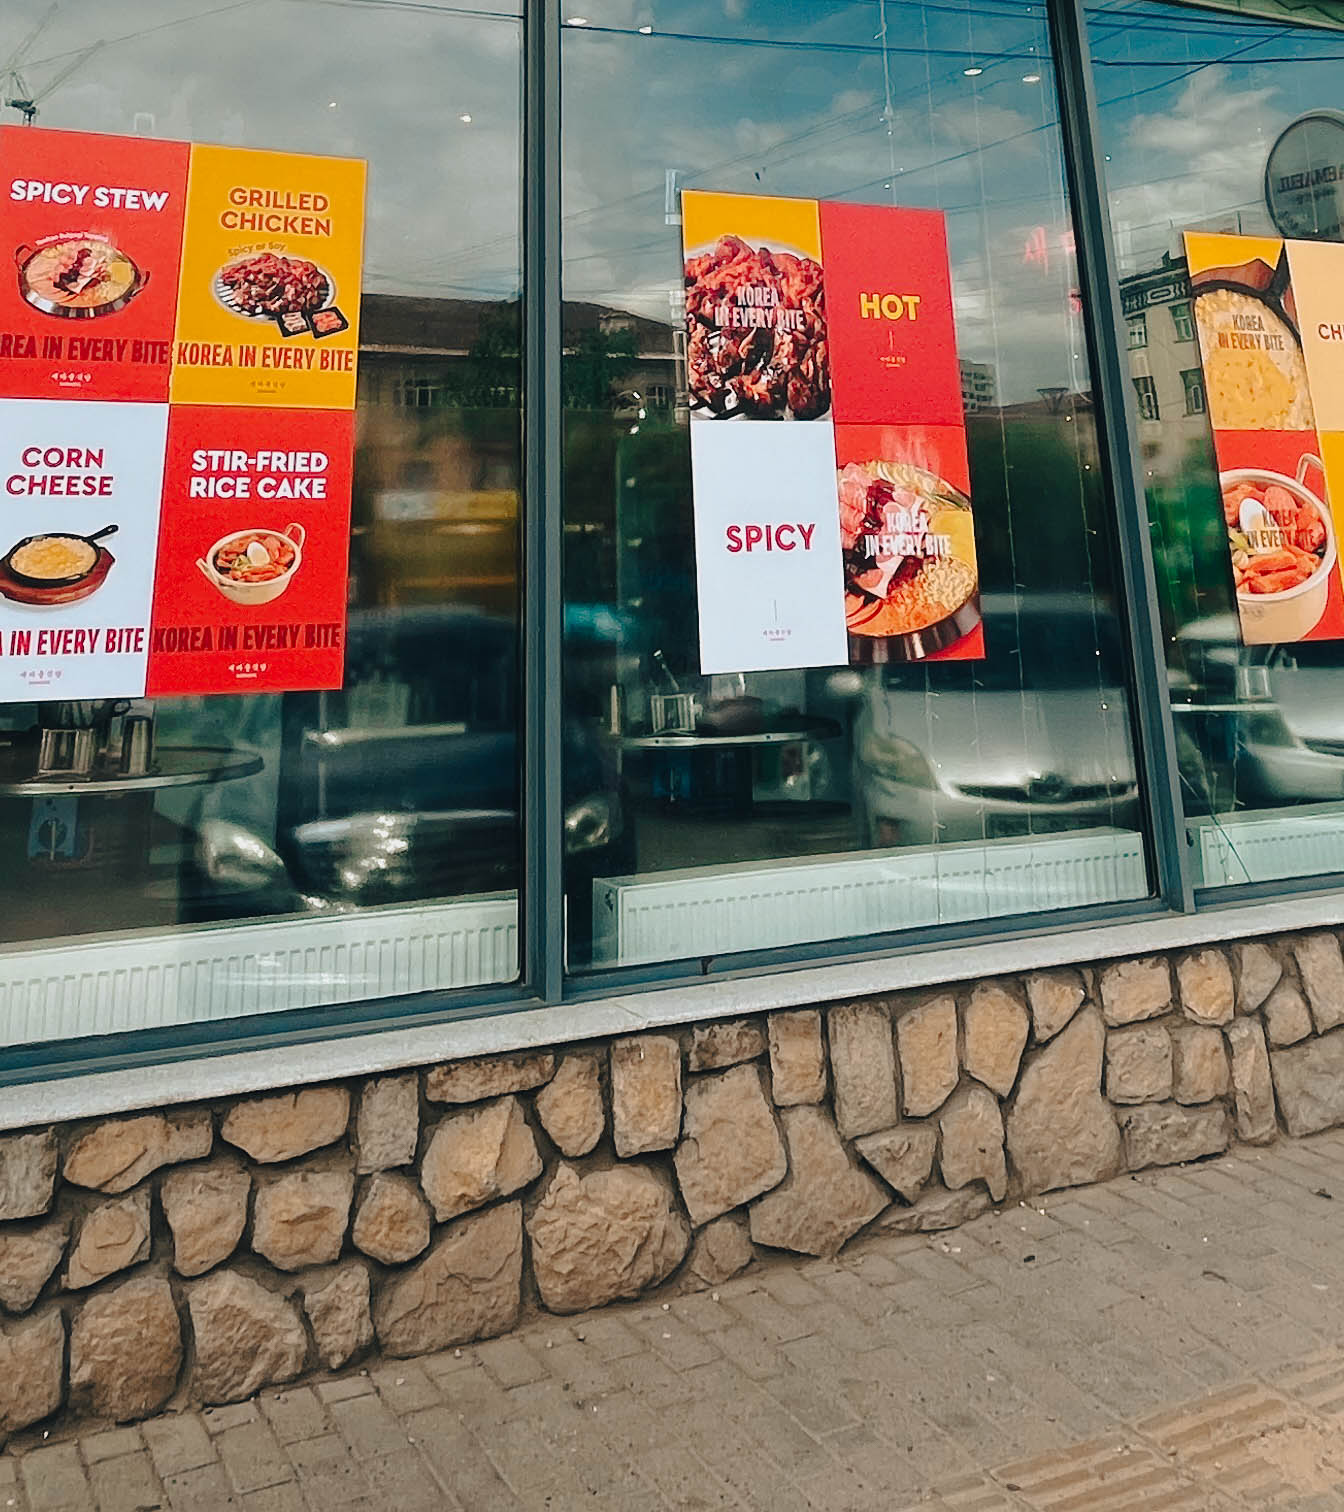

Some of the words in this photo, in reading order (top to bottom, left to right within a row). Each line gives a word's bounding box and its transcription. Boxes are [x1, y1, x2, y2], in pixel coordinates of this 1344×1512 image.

[10, 179, 88, 206] SPICY
[93, 187, 169, 212] STEW
[228, 187, 330, 212] GRILLED
[220, 210, 332, 237] CHICKEN
[737, 286, 780, 307] KOREA
[860, 292, 921, 321] HOT
[732, 307, 774, 328] EVERY
[42, 335, 63, 360] IN
[67, 336, 129, 362] EVERY
[131, 339, 169, 364] BITE
[177, 342, 233, 367] KOREA
[238, 345, 257, 368] IN
[261, 346, 315, 370] EVERY
[319, 349, 354, 372] BITE
[21, 446, 104, 469] CORN
[191, 450, 329, 473] STIR-FRIED
[6, 473, 114, 497] CHEESE
[189, 477, 250, 499] RICE
[256, 477, 326, 499] CAKE
[726, 524, 815, 553] SPICY
[9, 630, 31, 656] IN
[37, 629, 100, 655] EVERY
[105, 627, 145, 653] BITE
[153, 626, 213, 653] KOREA
[218, 625, 238, 651] IN
[243, 624, 301, 650] EVERY
[303, 623, 341, 648] BITE
